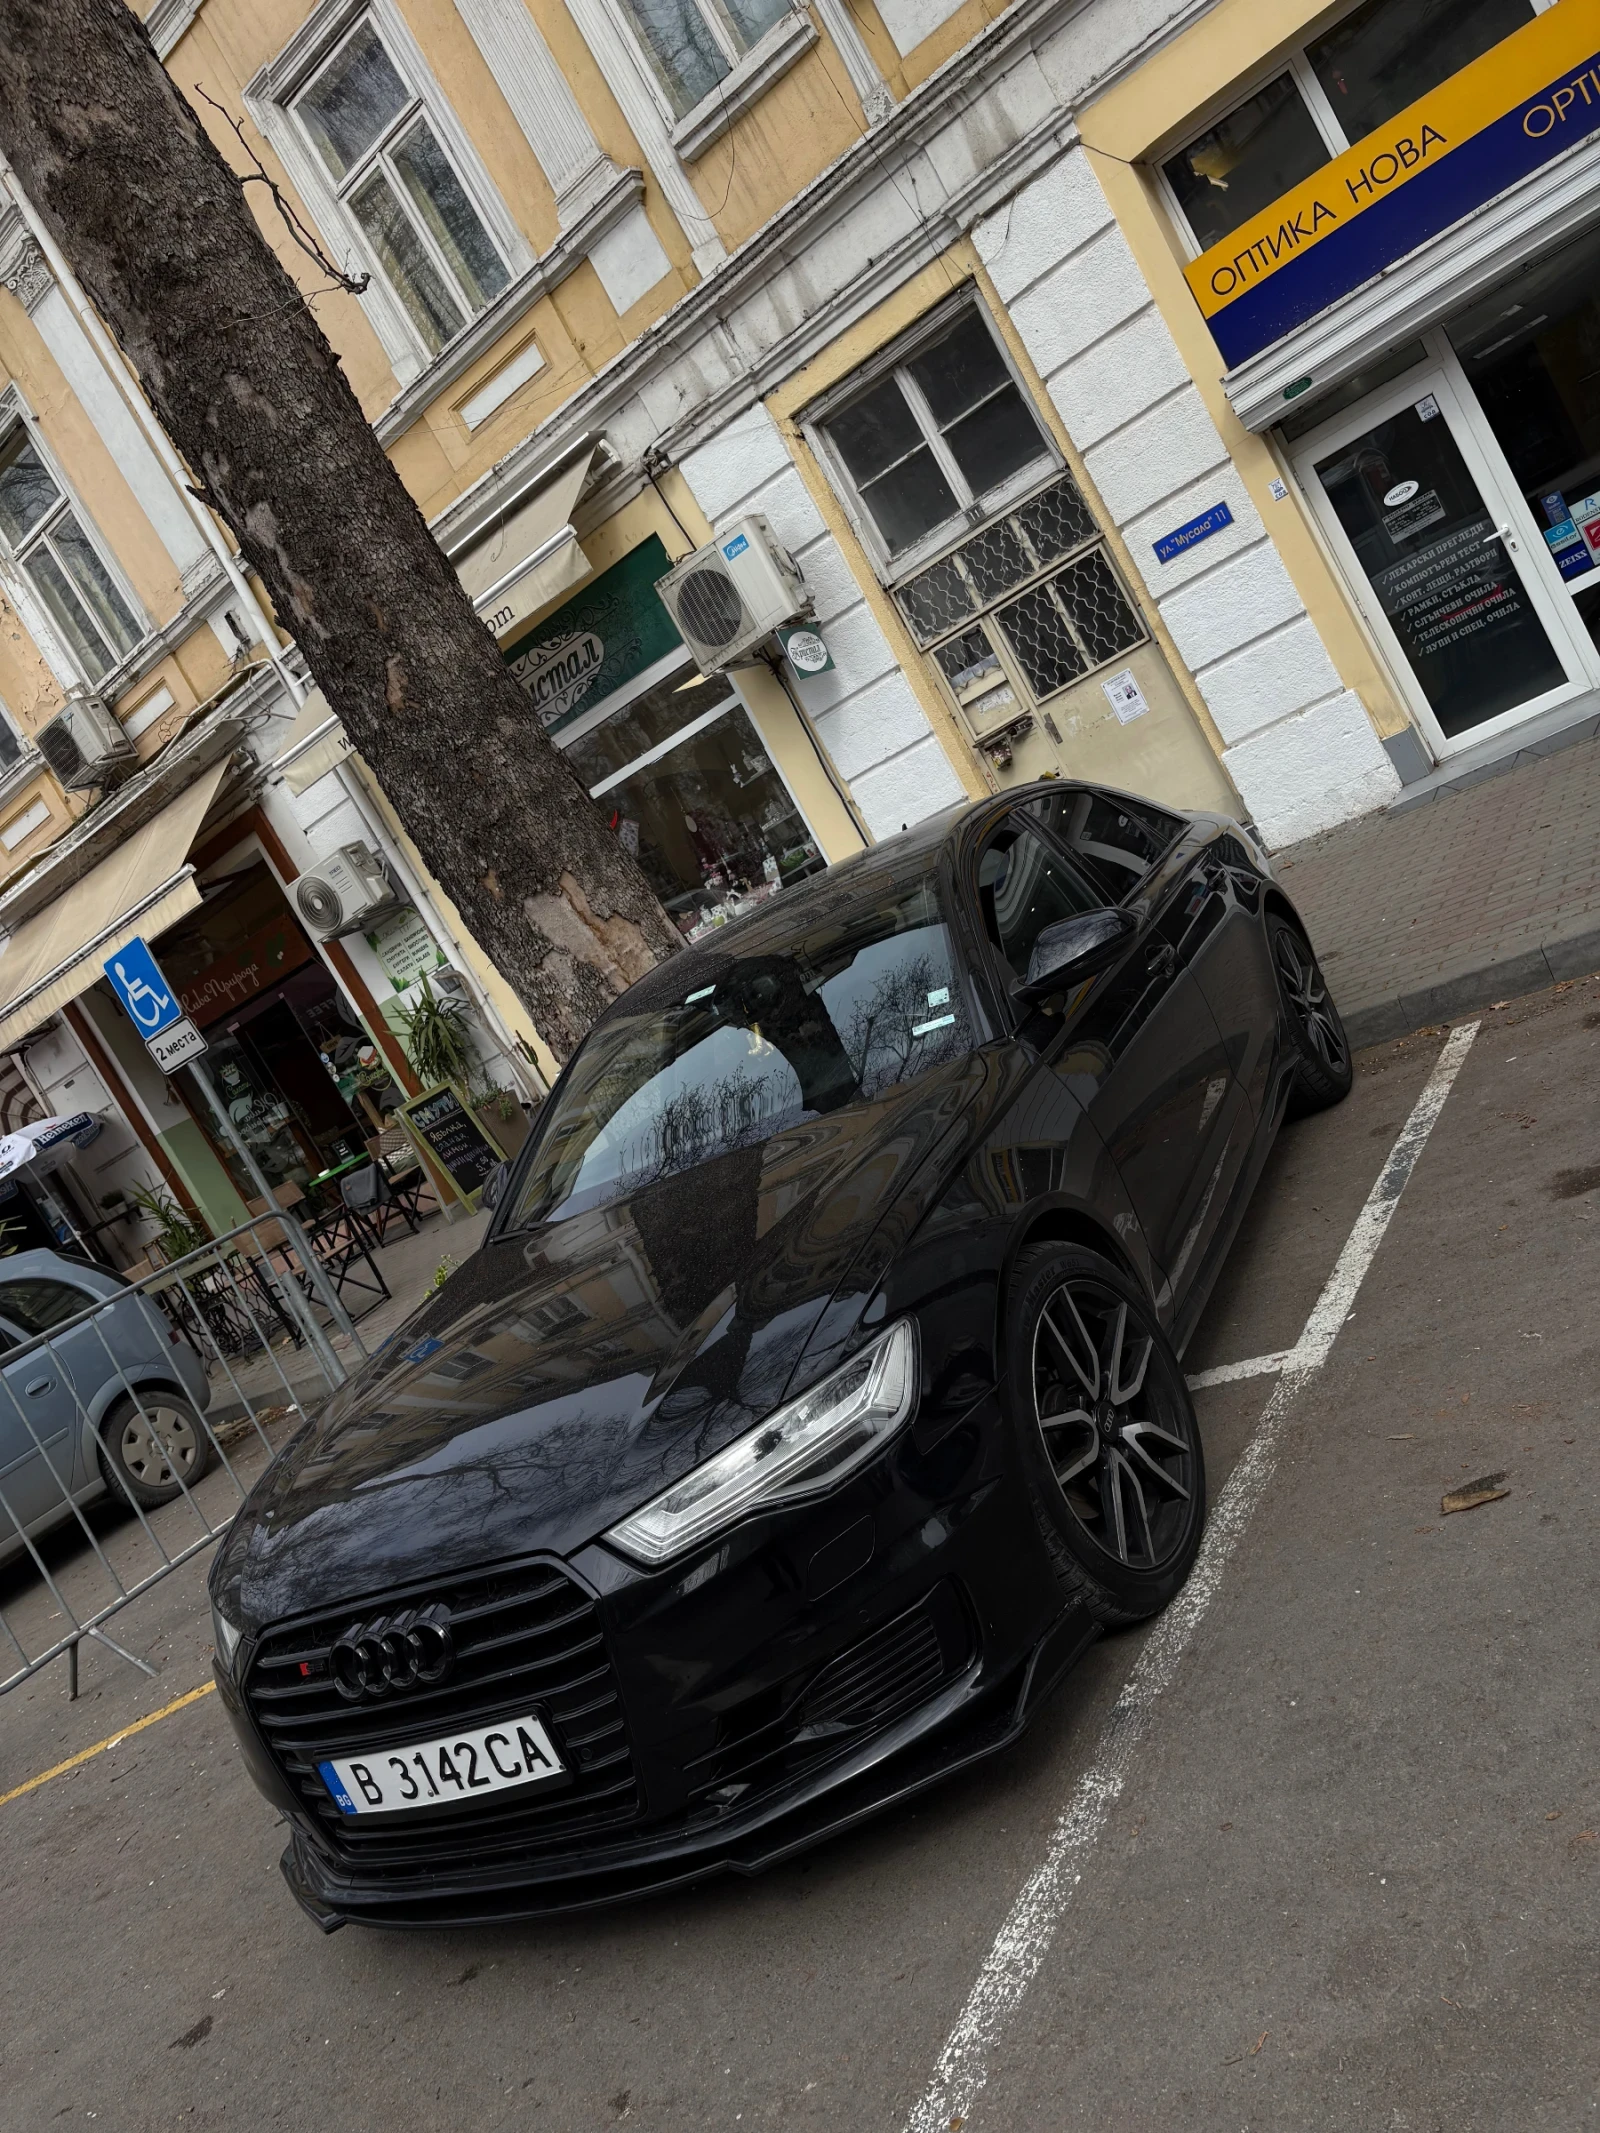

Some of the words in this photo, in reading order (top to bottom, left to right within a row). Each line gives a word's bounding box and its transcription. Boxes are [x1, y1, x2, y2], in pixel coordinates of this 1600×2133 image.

[1211, 200, 1337, 295] ОПТИКА
[1345, 124, 1448, 204] НОВА
[1160, 545, 1174, 558] ул.
[1215, 509, 1226, 522] 11
[1388, 549, 1436, 581] ЛЕКАРСКИ
[1437, 522, 1484, 554] ПРЕГЛЕДИ
[1394, 556, 1457, 593] КОМПЮТЪРЕН
[1457, 540, 1481, 560] ТЕСТ
[1400, 588, 1426, 606] КОНТ.
[1426, 572, 1454, 593] ЛЕЩИ,
[1455, 548, 1498, 578] РАЗТВОРИ
[1559, 549, 1588, 569] ZEISS
[1407, 594, 1442, 617] РАМКИ,
[1442, 574, 1481, 598] СТЪКЛА
[1414, 598, 1465, 628] СЛЪНЧЕВИ
[1465, 581, 1498, 602] ОЧИЛА
[1418, 603, 1485, 642] ТЕЛЕСКОПИЧНИ
[1485, 587, 1516, 608] ОЧИЛА
[1425, 636, 1451, 655] ЛУПИ
[1453, 631, 1460, 641] И
[1459, 619, 1487, 638] СПЕЦ.
[1486, 601, 1521, 623] ОЧИЛА
[155, 1047, 168, 1061] 2
[165, 1031, 197, 1056] места
[37, 1113, 88, 1145] Heineken
[411, 1091, 460, 1128] СМУТИ
[336, 1794, 351, 1807] BG
[349, 1763, 383, 1805] B
